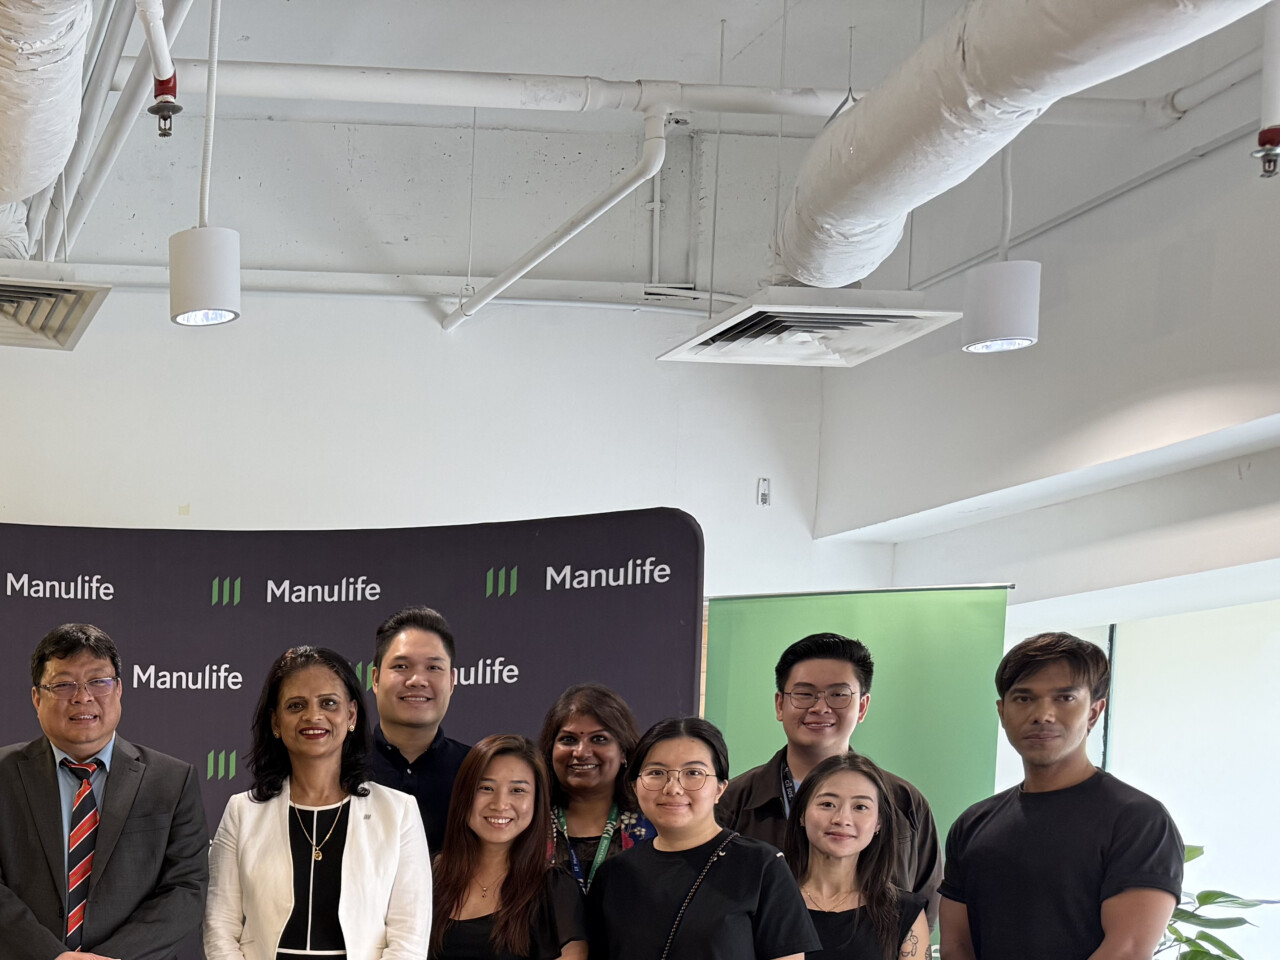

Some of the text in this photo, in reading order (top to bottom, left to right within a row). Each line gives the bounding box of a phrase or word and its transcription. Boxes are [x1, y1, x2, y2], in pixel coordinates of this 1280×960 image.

[6, 572, 115, 601] Manulife
[545, 556, 671, 591] Manulife
[266, 575, 381, 603] Manulife
[132, 663, 243, 690] Manulife
[454, 656, 519, 686] ulife
